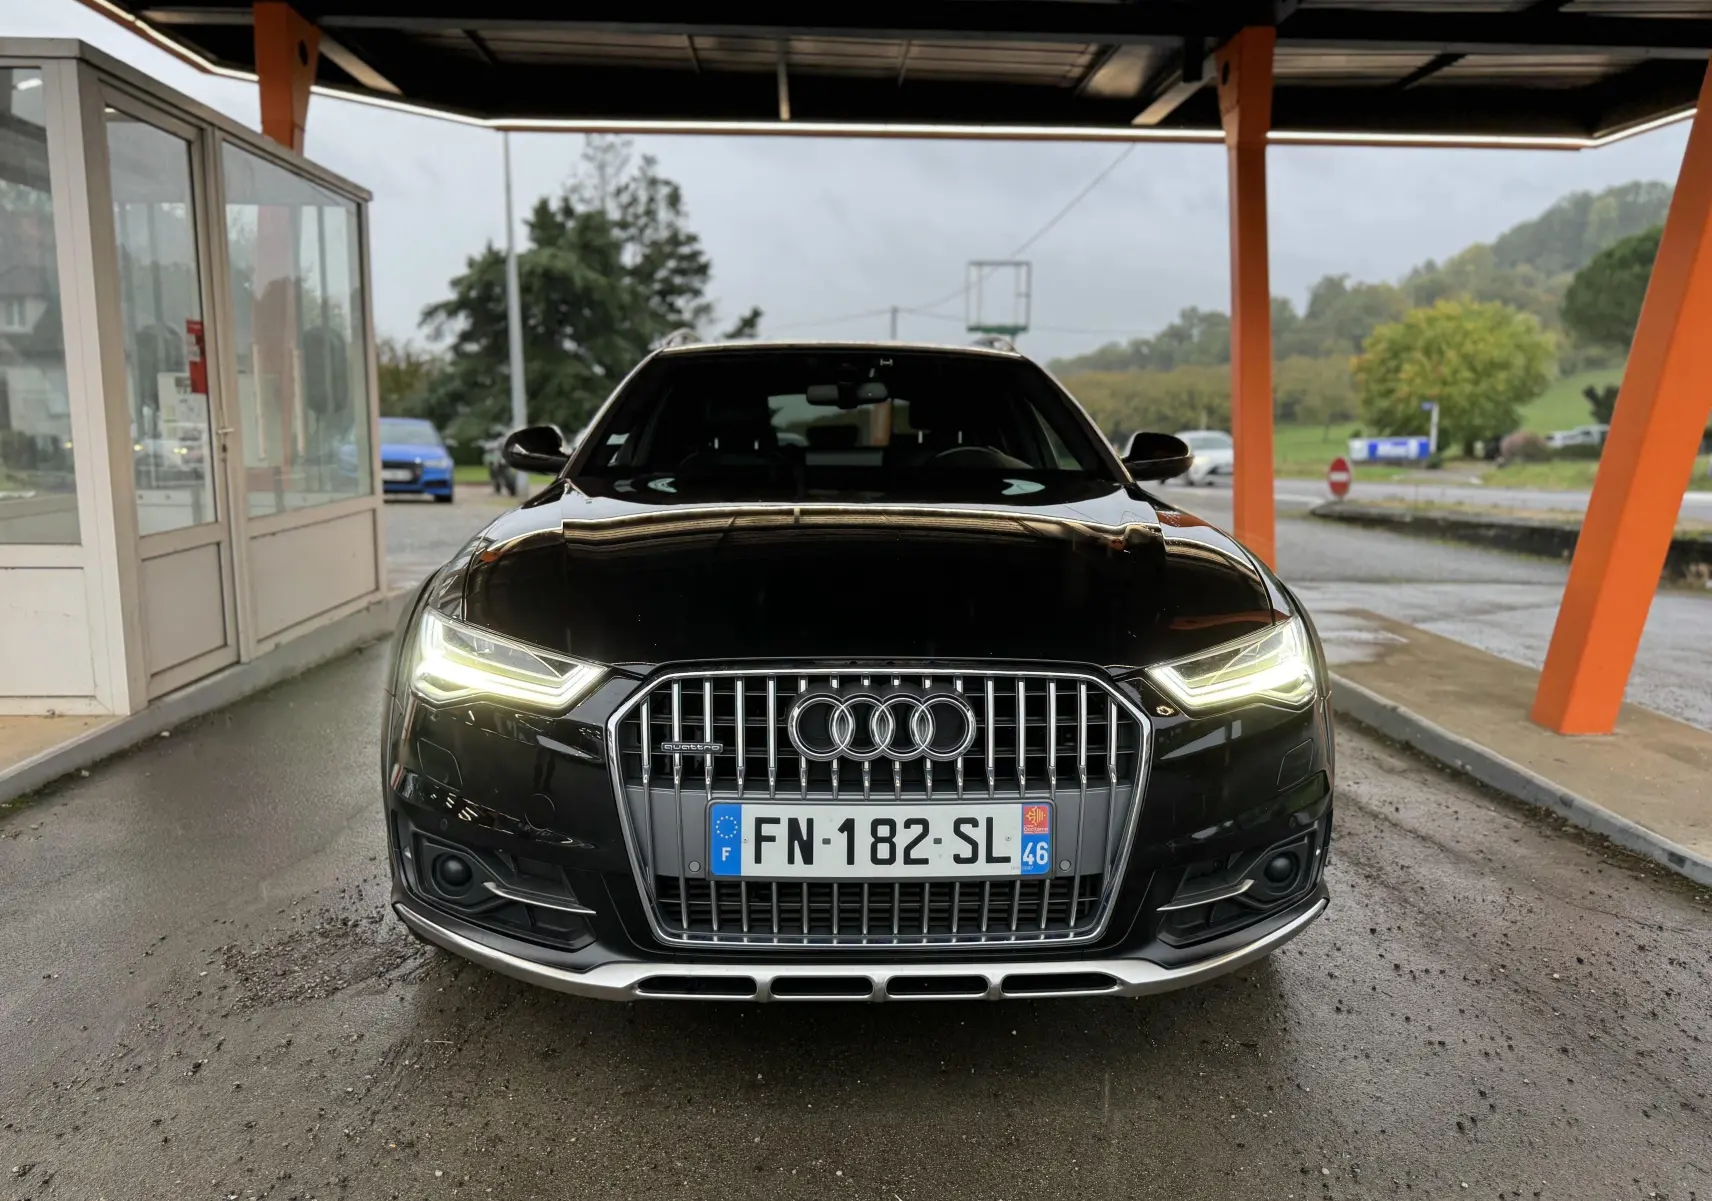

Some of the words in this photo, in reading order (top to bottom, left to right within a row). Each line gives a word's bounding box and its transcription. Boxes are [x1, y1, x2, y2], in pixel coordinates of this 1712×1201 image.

[754, 817, 1011, 865] FN-182-SL
[1022, 841, 1049, 865] 46
[721, 847, 732, 862] F
